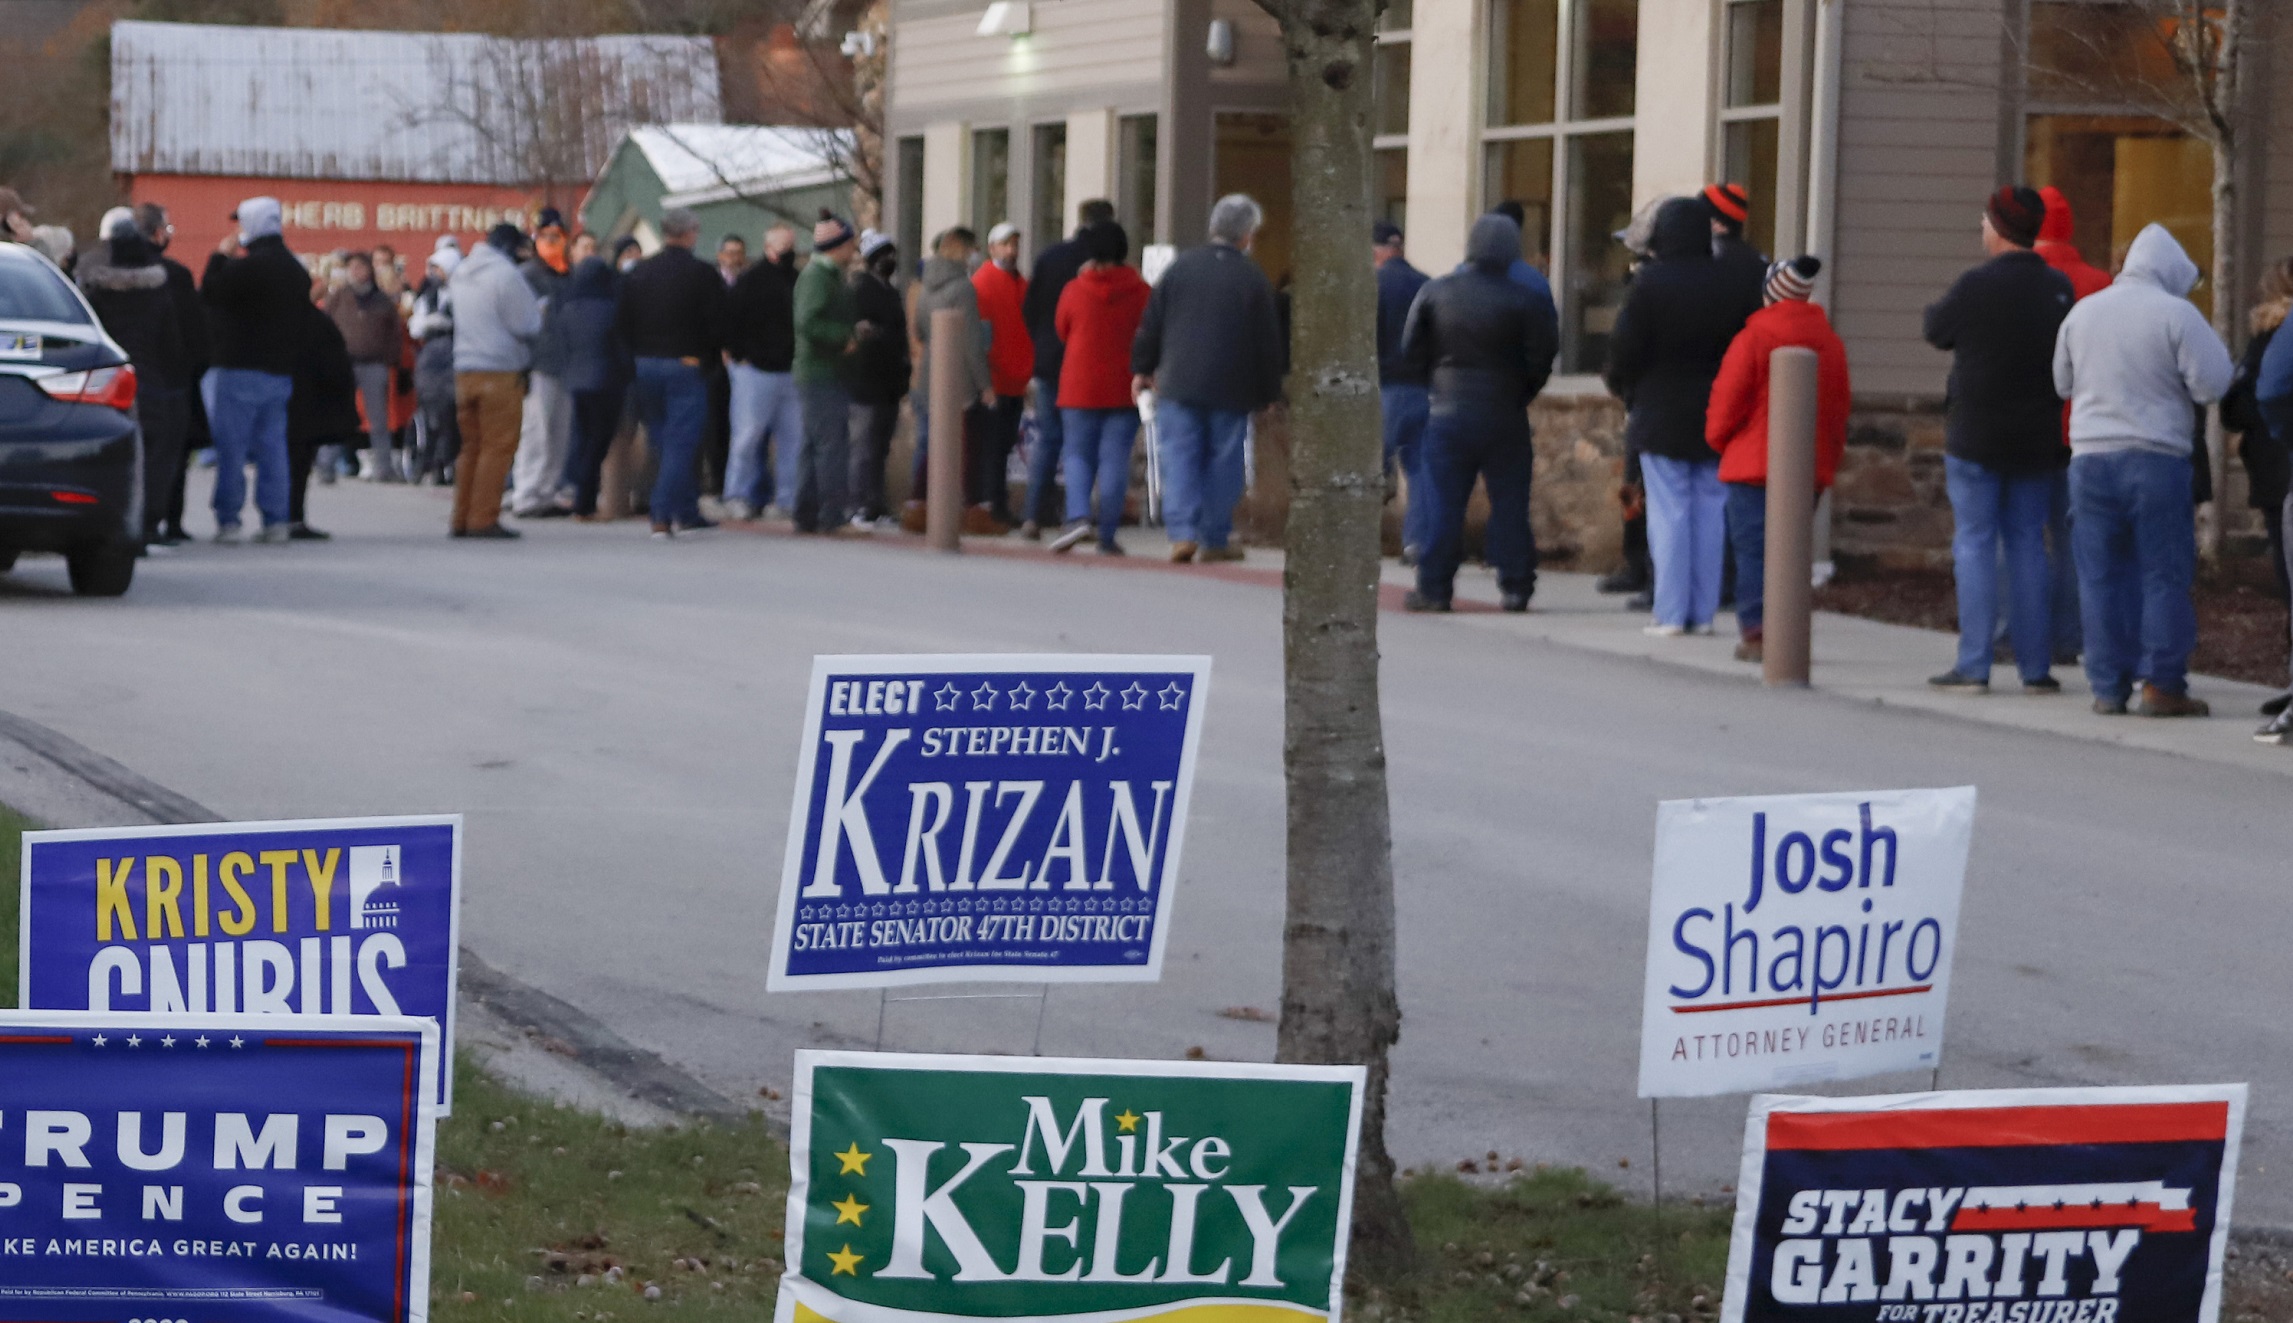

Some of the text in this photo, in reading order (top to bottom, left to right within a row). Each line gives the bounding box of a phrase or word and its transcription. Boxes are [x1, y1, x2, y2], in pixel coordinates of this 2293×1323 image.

[830, 680, 924, 715] ELECT
[920, 726, 1120, 763] STEPHEN J.
[802, 728, 1173, 898] KRIZAN
[1742, 801, 1898, 915] Josh
[95, 847, 342, 942] KRISTY
[794, 914, 1150, 951] STATE SENATOR 47TH DISTRICT
[1668, 898, 1941, 1017] Shapiro
[1671, 1014, 1927, 1062] ATTORNEY GENERAL
[0, 1110, 389, 1172] RUMP
[1007, 1095, 1231, 1180] Mike
[872, 1138, 1319, 1288] KELLY
[1780, 1187, 1966, 1237] STACY
[4, 1238, 358, 1260] KE AMERICA GREAT AGAIN!
[1770, 1228, 2141, 1306] GARRITY
[1876, 1304, 1920, 1322] FOR
